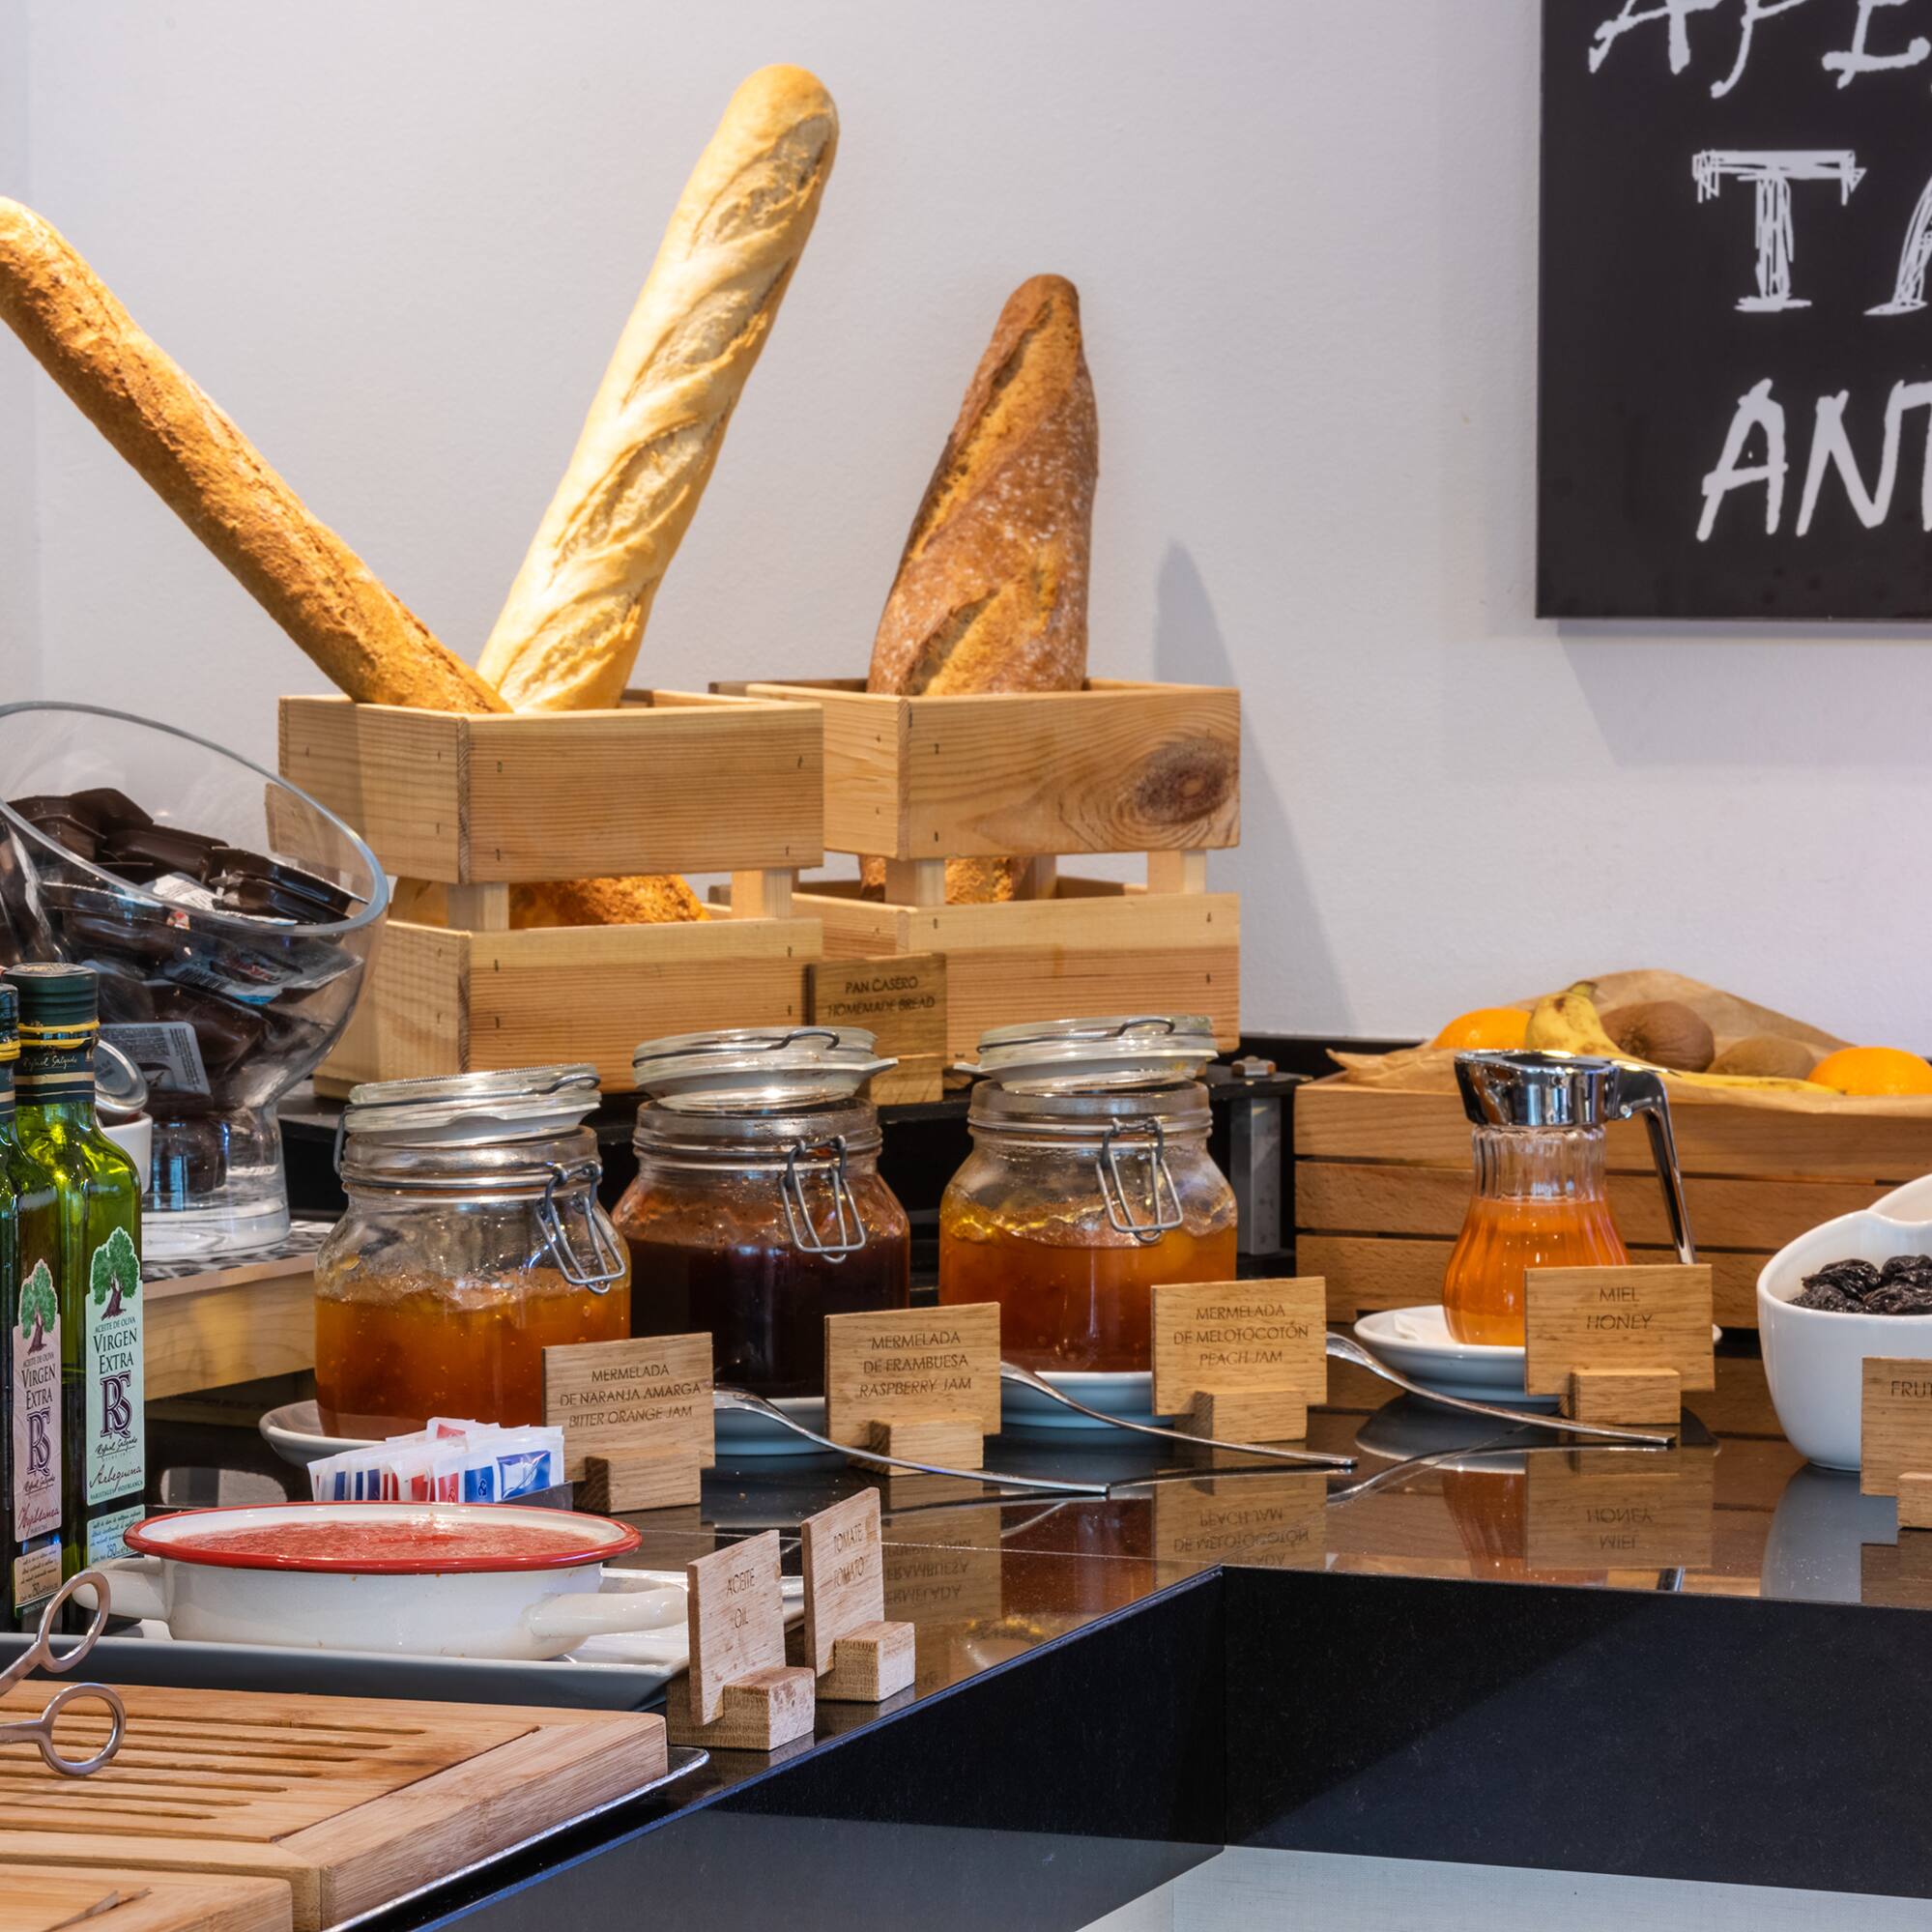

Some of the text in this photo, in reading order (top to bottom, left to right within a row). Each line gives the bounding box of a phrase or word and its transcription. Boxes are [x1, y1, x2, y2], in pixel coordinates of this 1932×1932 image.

[845, 975, 918, 995] PAN CASERO
[827, 995, 936, 1018] HOMEMADE BREAD
[1600, 1286, 1640, 1302] MIEL
[1196, 1304, 1285, 1321] MERMELADA
[1586, 1313, 1653, 1331] HONEY
[93, 1327, 137, 1354] VIRGEN
[872, 1331, 962, 1350] MERMELADA
[1173, 1330, 1192, 1344] DE
[99, 1351, 134, 1374] EXTRA
[863, 1353, 968, 1373] DE FRAMBUESA
[1199, 1350, 1283, 1367] PEACH JAM
[21, 1363, 56, 1389] VIRGEN
[591, 1364, 670, 1383] MERMELADA
[560, 1382, 702, 1406] DE NARANJA AMARGA
[859, 1377, 972, 1399] RASPBERRY JAM
[26, 1388, 53, 1410] EXTRA
[568, 1405, 693, 1427] BITTER ORANGE JAM
[735, 1607, 749, 1629] OIL
